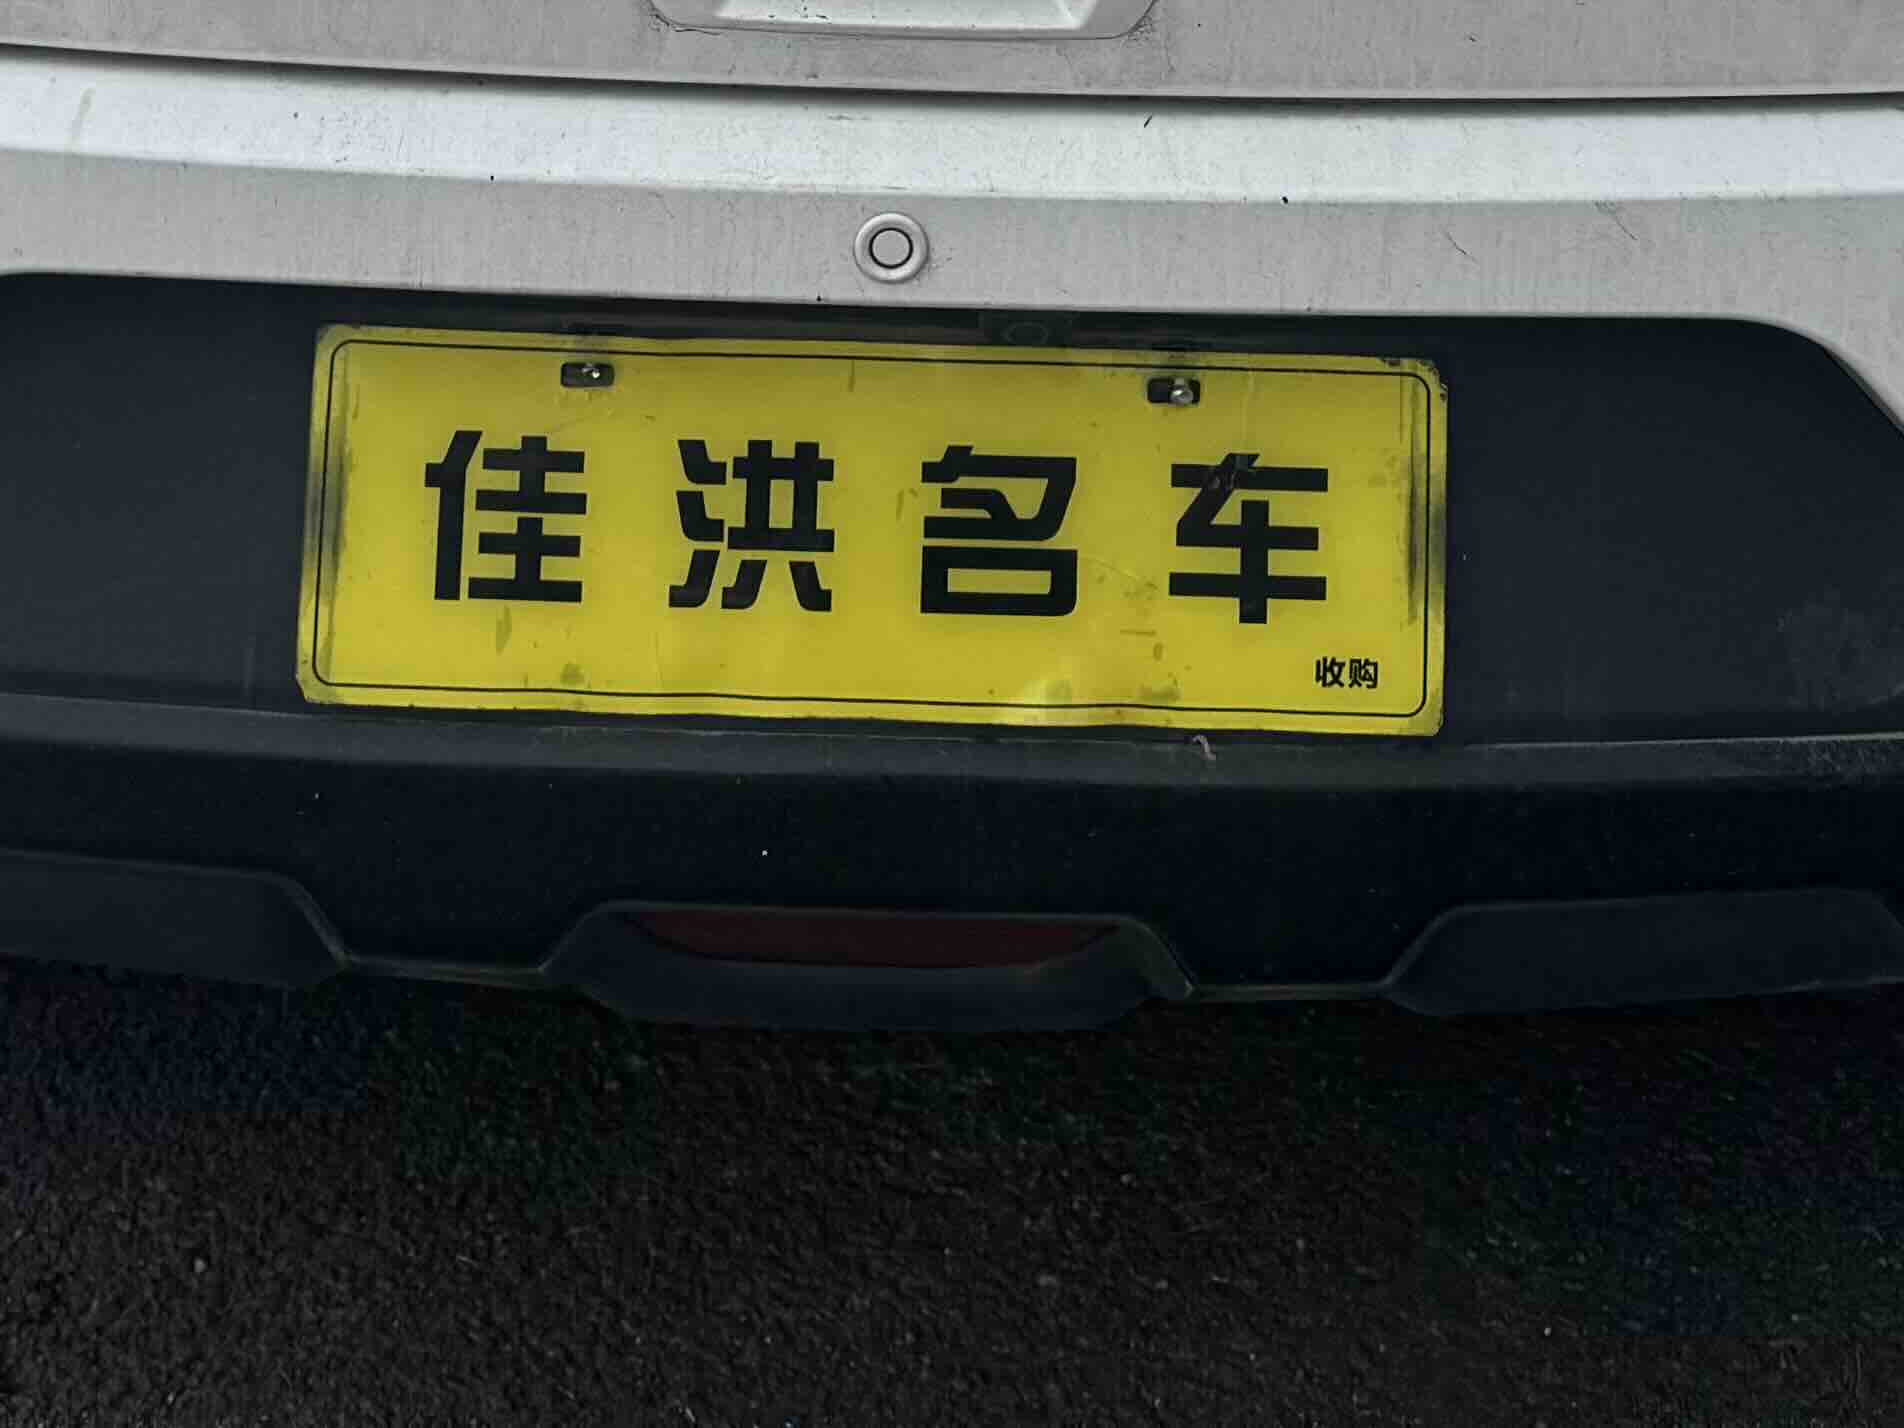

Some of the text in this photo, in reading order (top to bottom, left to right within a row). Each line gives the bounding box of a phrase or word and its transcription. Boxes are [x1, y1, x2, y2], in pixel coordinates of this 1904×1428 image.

[424, 429, 1329, 626] 佳洪名车
[1314, 656, 1379, 689] 收购
